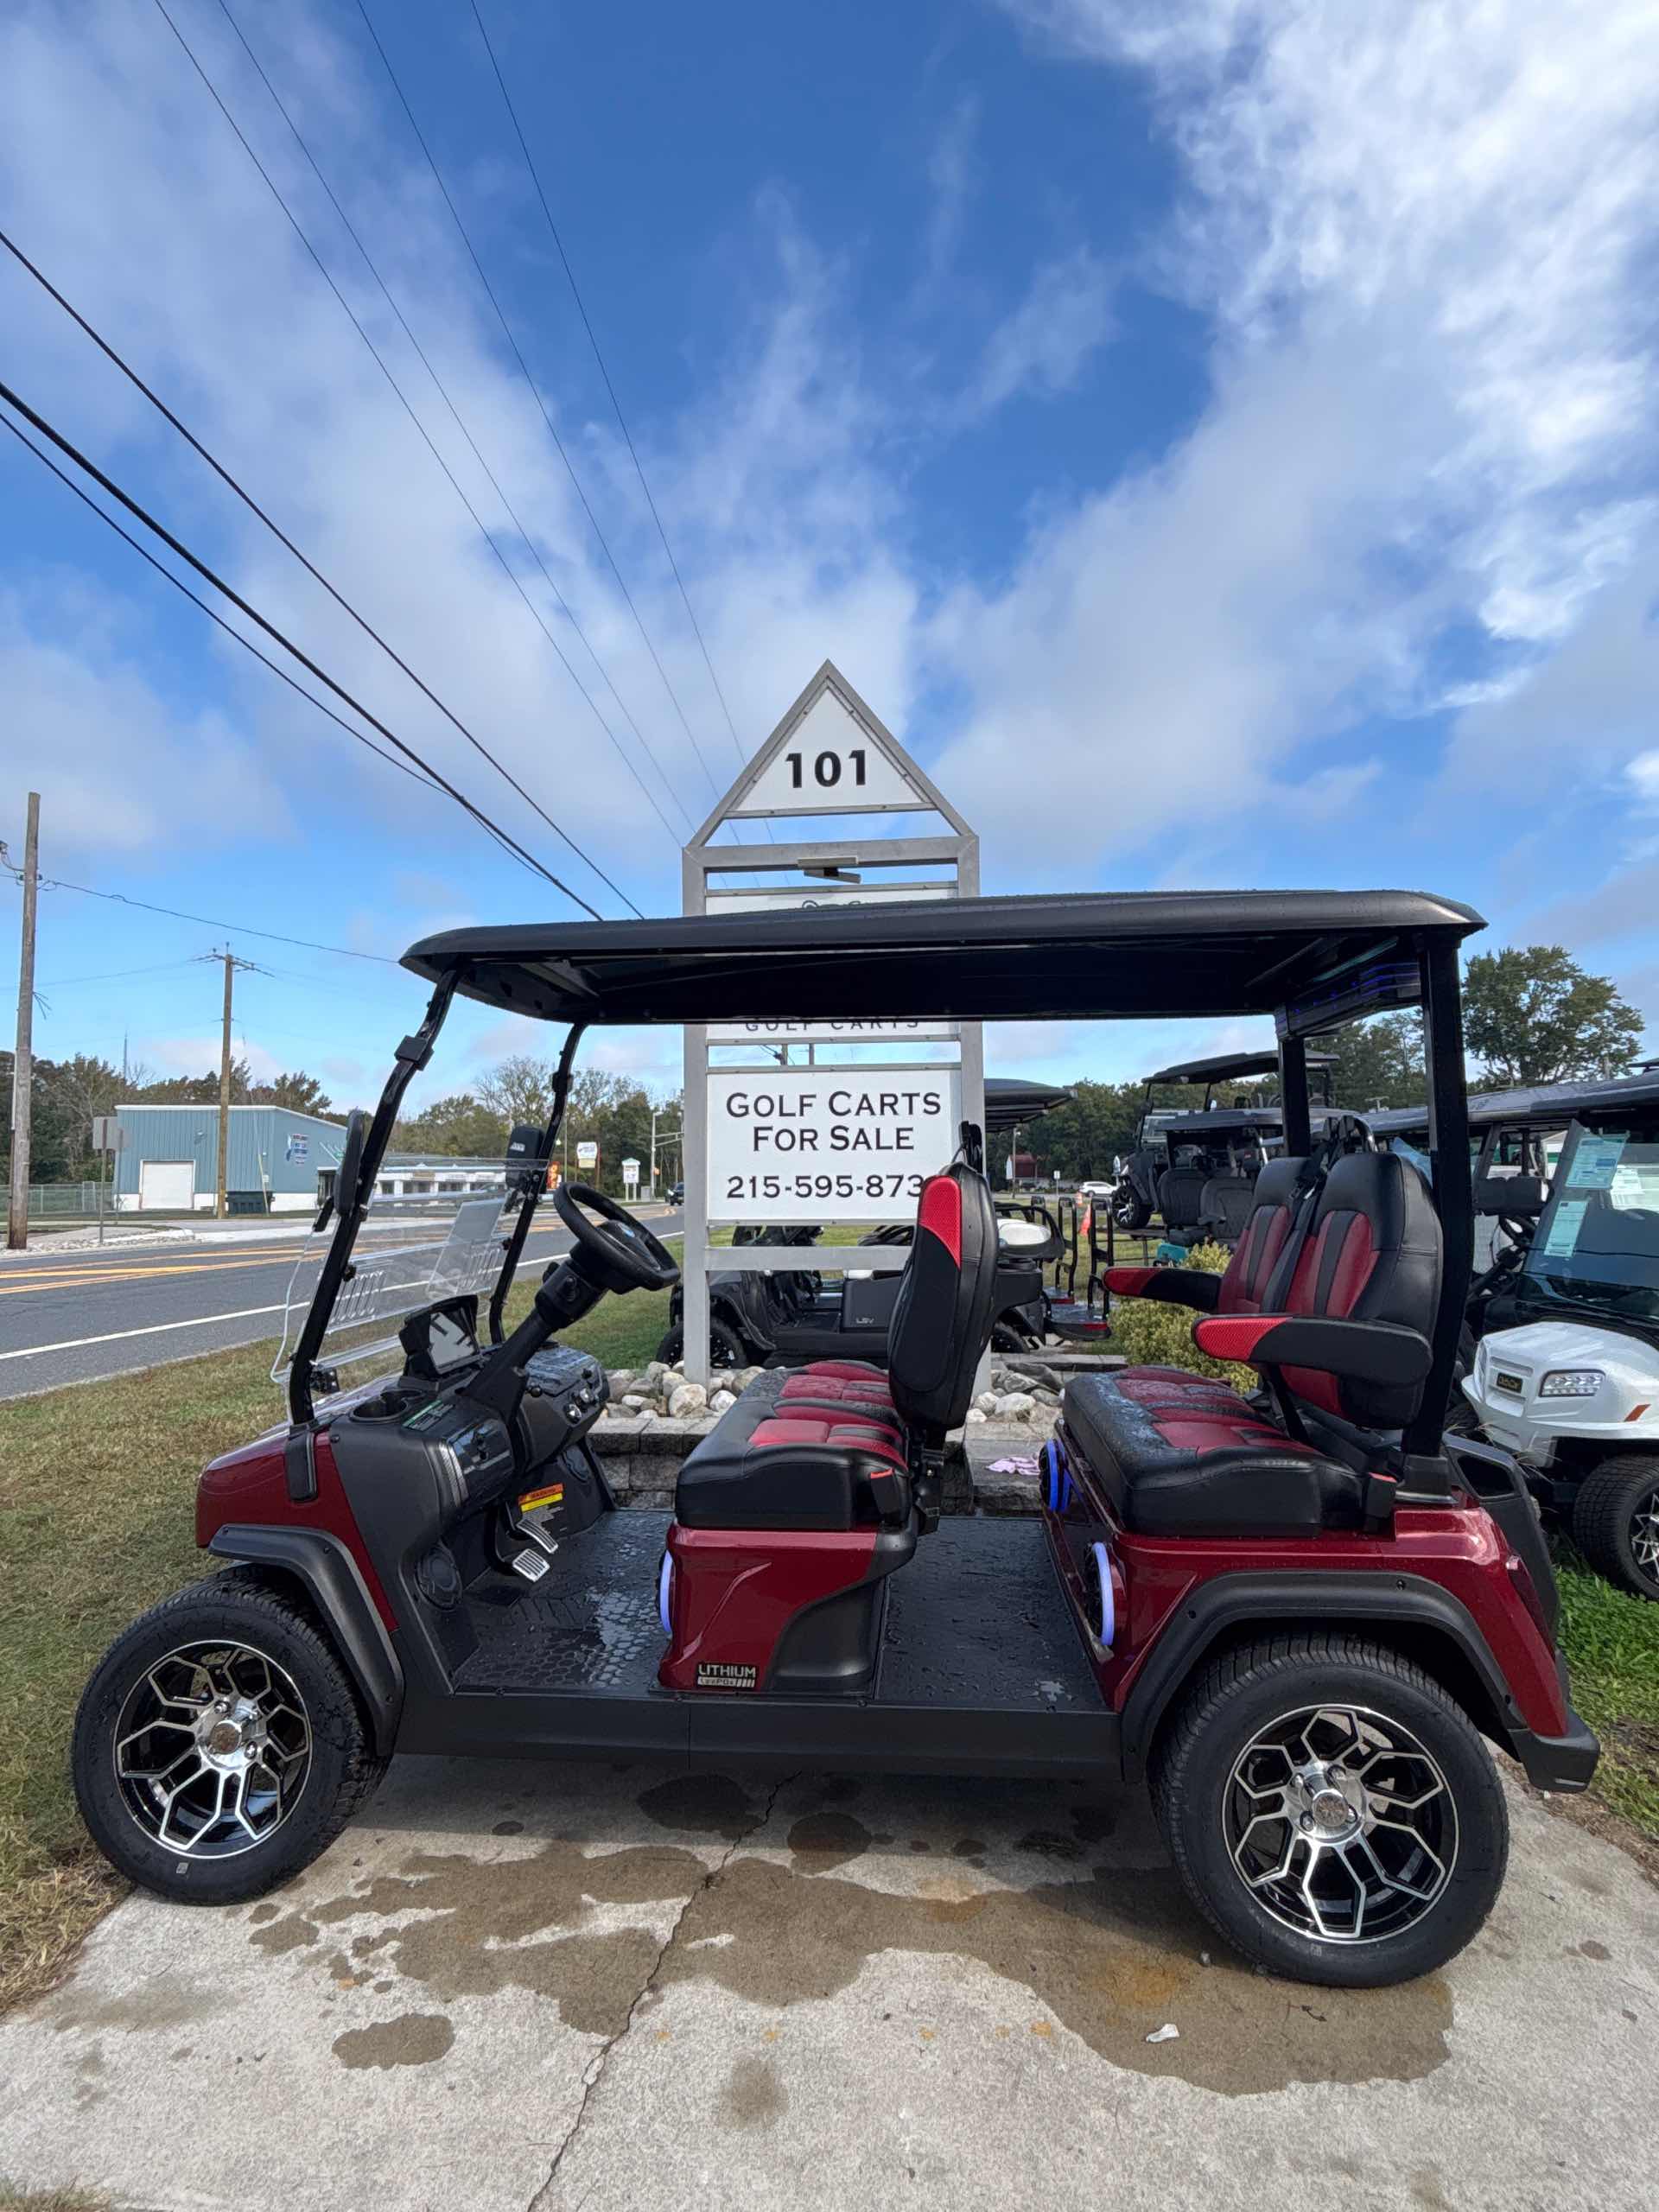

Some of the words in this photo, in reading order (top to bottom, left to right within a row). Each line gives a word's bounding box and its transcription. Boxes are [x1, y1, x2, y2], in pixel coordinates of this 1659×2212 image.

[785, 749, 866, 788] 101
[726, 1092, 817, 1118] GOLF
[828, 1090, 941, 1116] CARTS
[753, 1126, 819, 1152] FOR
[830, 1125, 914, 1151] SALE
[727, 1174, 924, 1198] 215-595-873
[698, 1663, 756, 1678] LITHIUM
